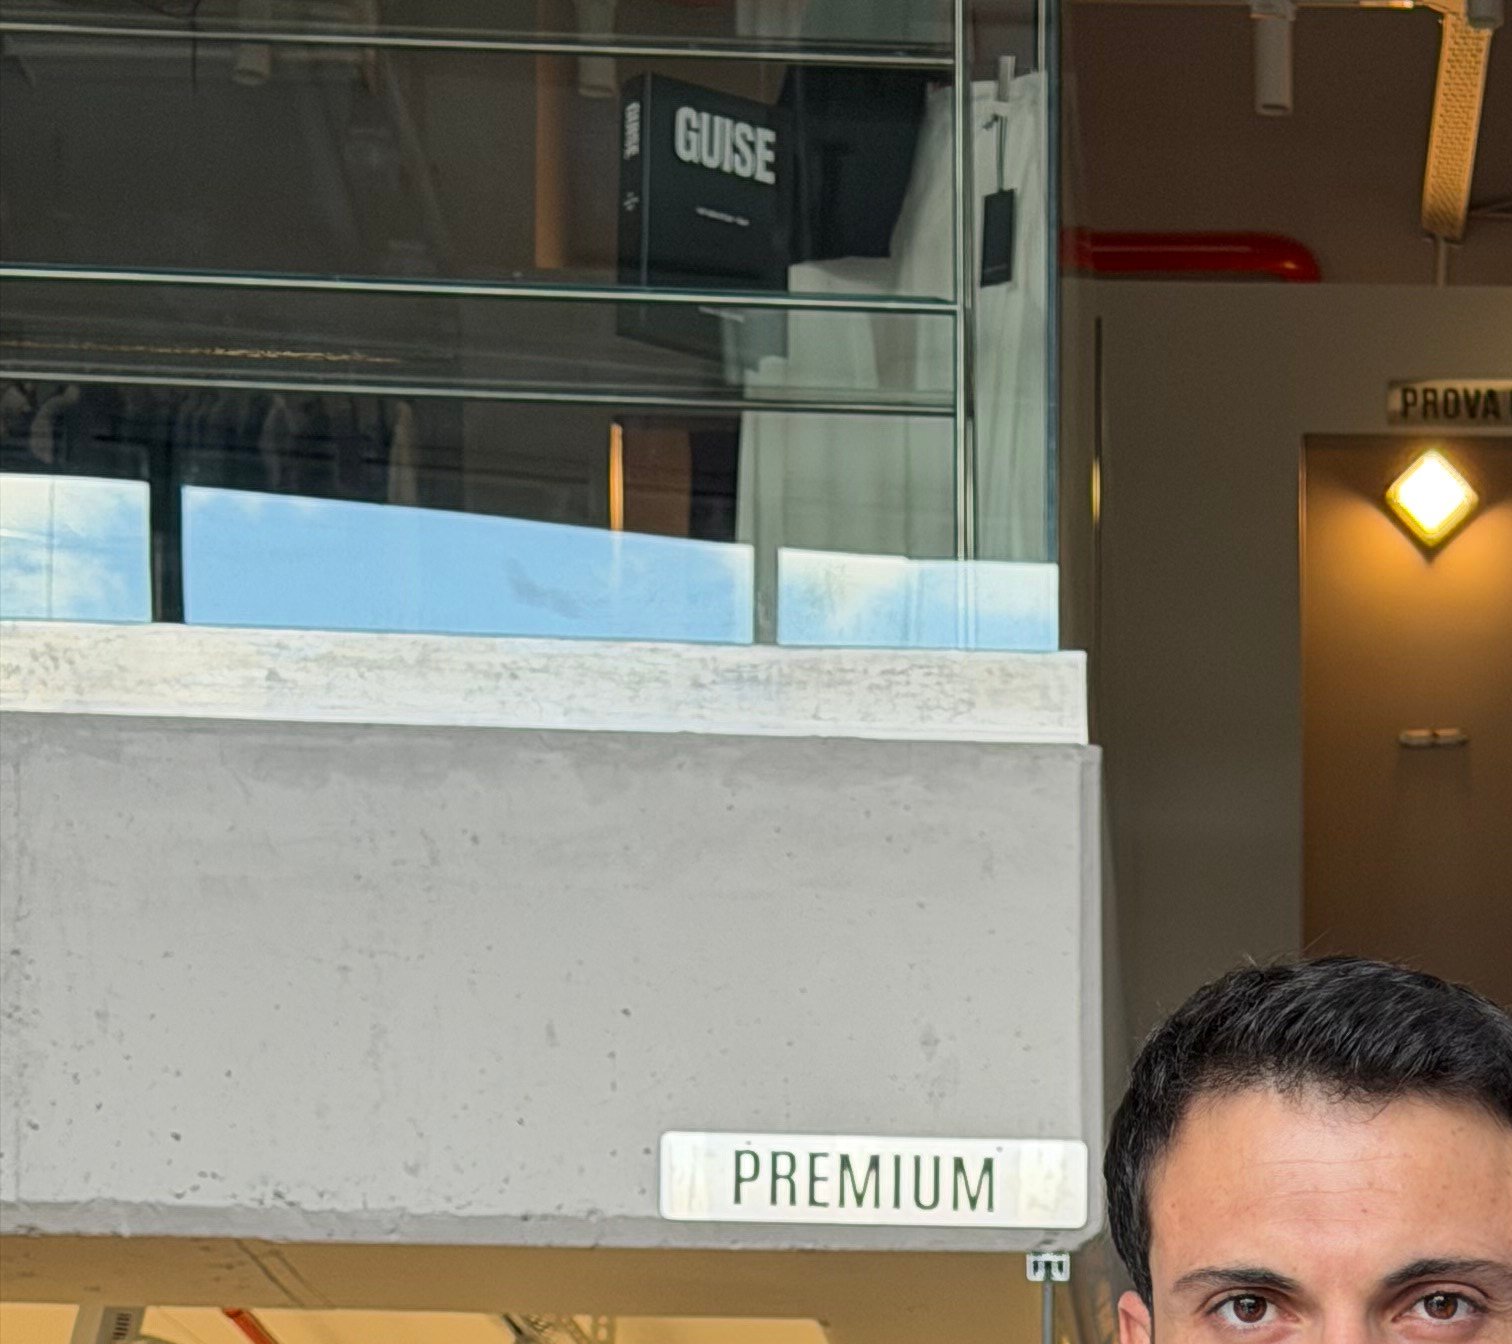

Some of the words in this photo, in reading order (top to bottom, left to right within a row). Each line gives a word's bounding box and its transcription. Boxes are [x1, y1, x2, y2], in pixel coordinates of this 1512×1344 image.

[674, 106, 777, 185] GUISE
[1401, 387, 1500, 420] PROVA
[733, 1149, 995, 1212] PREMIUM
